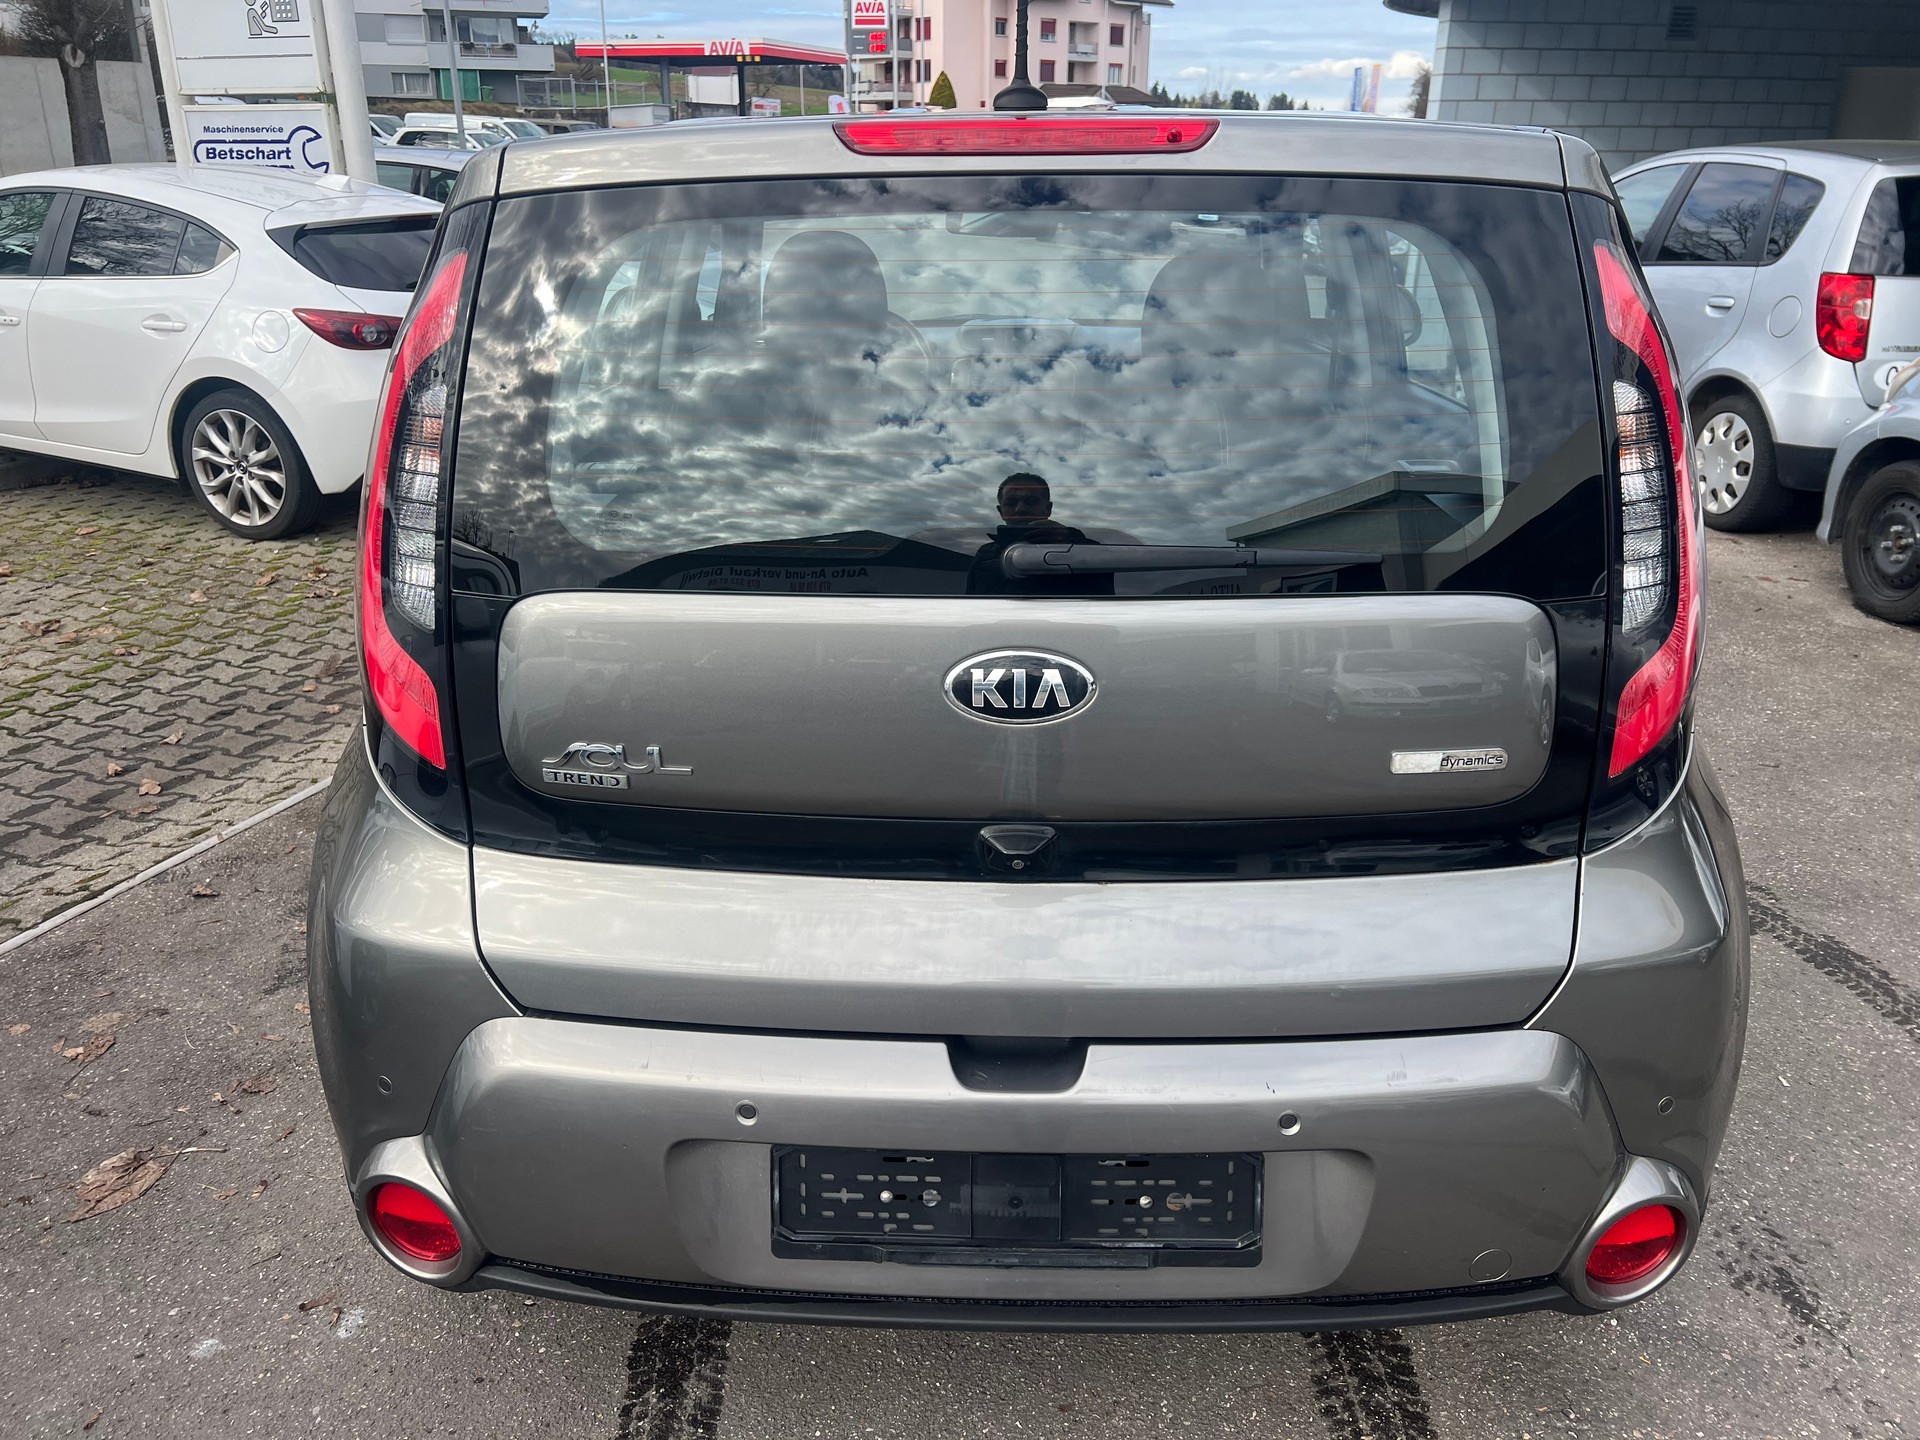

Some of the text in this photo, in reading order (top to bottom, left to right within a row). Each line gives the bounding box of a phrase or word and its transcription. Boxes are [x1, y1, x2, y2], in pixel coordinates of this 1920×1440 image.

[855, 0, 885, 13] AVIA
[709, 38, 745, 55] AVIA
[203, 125, 284, 133] Maschinenservice
[205, 147, 292, 160] Betschart
[970, 668, 1071, 708] KIA
[541, 741, 694, 775] SOUL
[1440, 754, 1503, 769] dynamics
[549, 770, 622, 787] TREND
